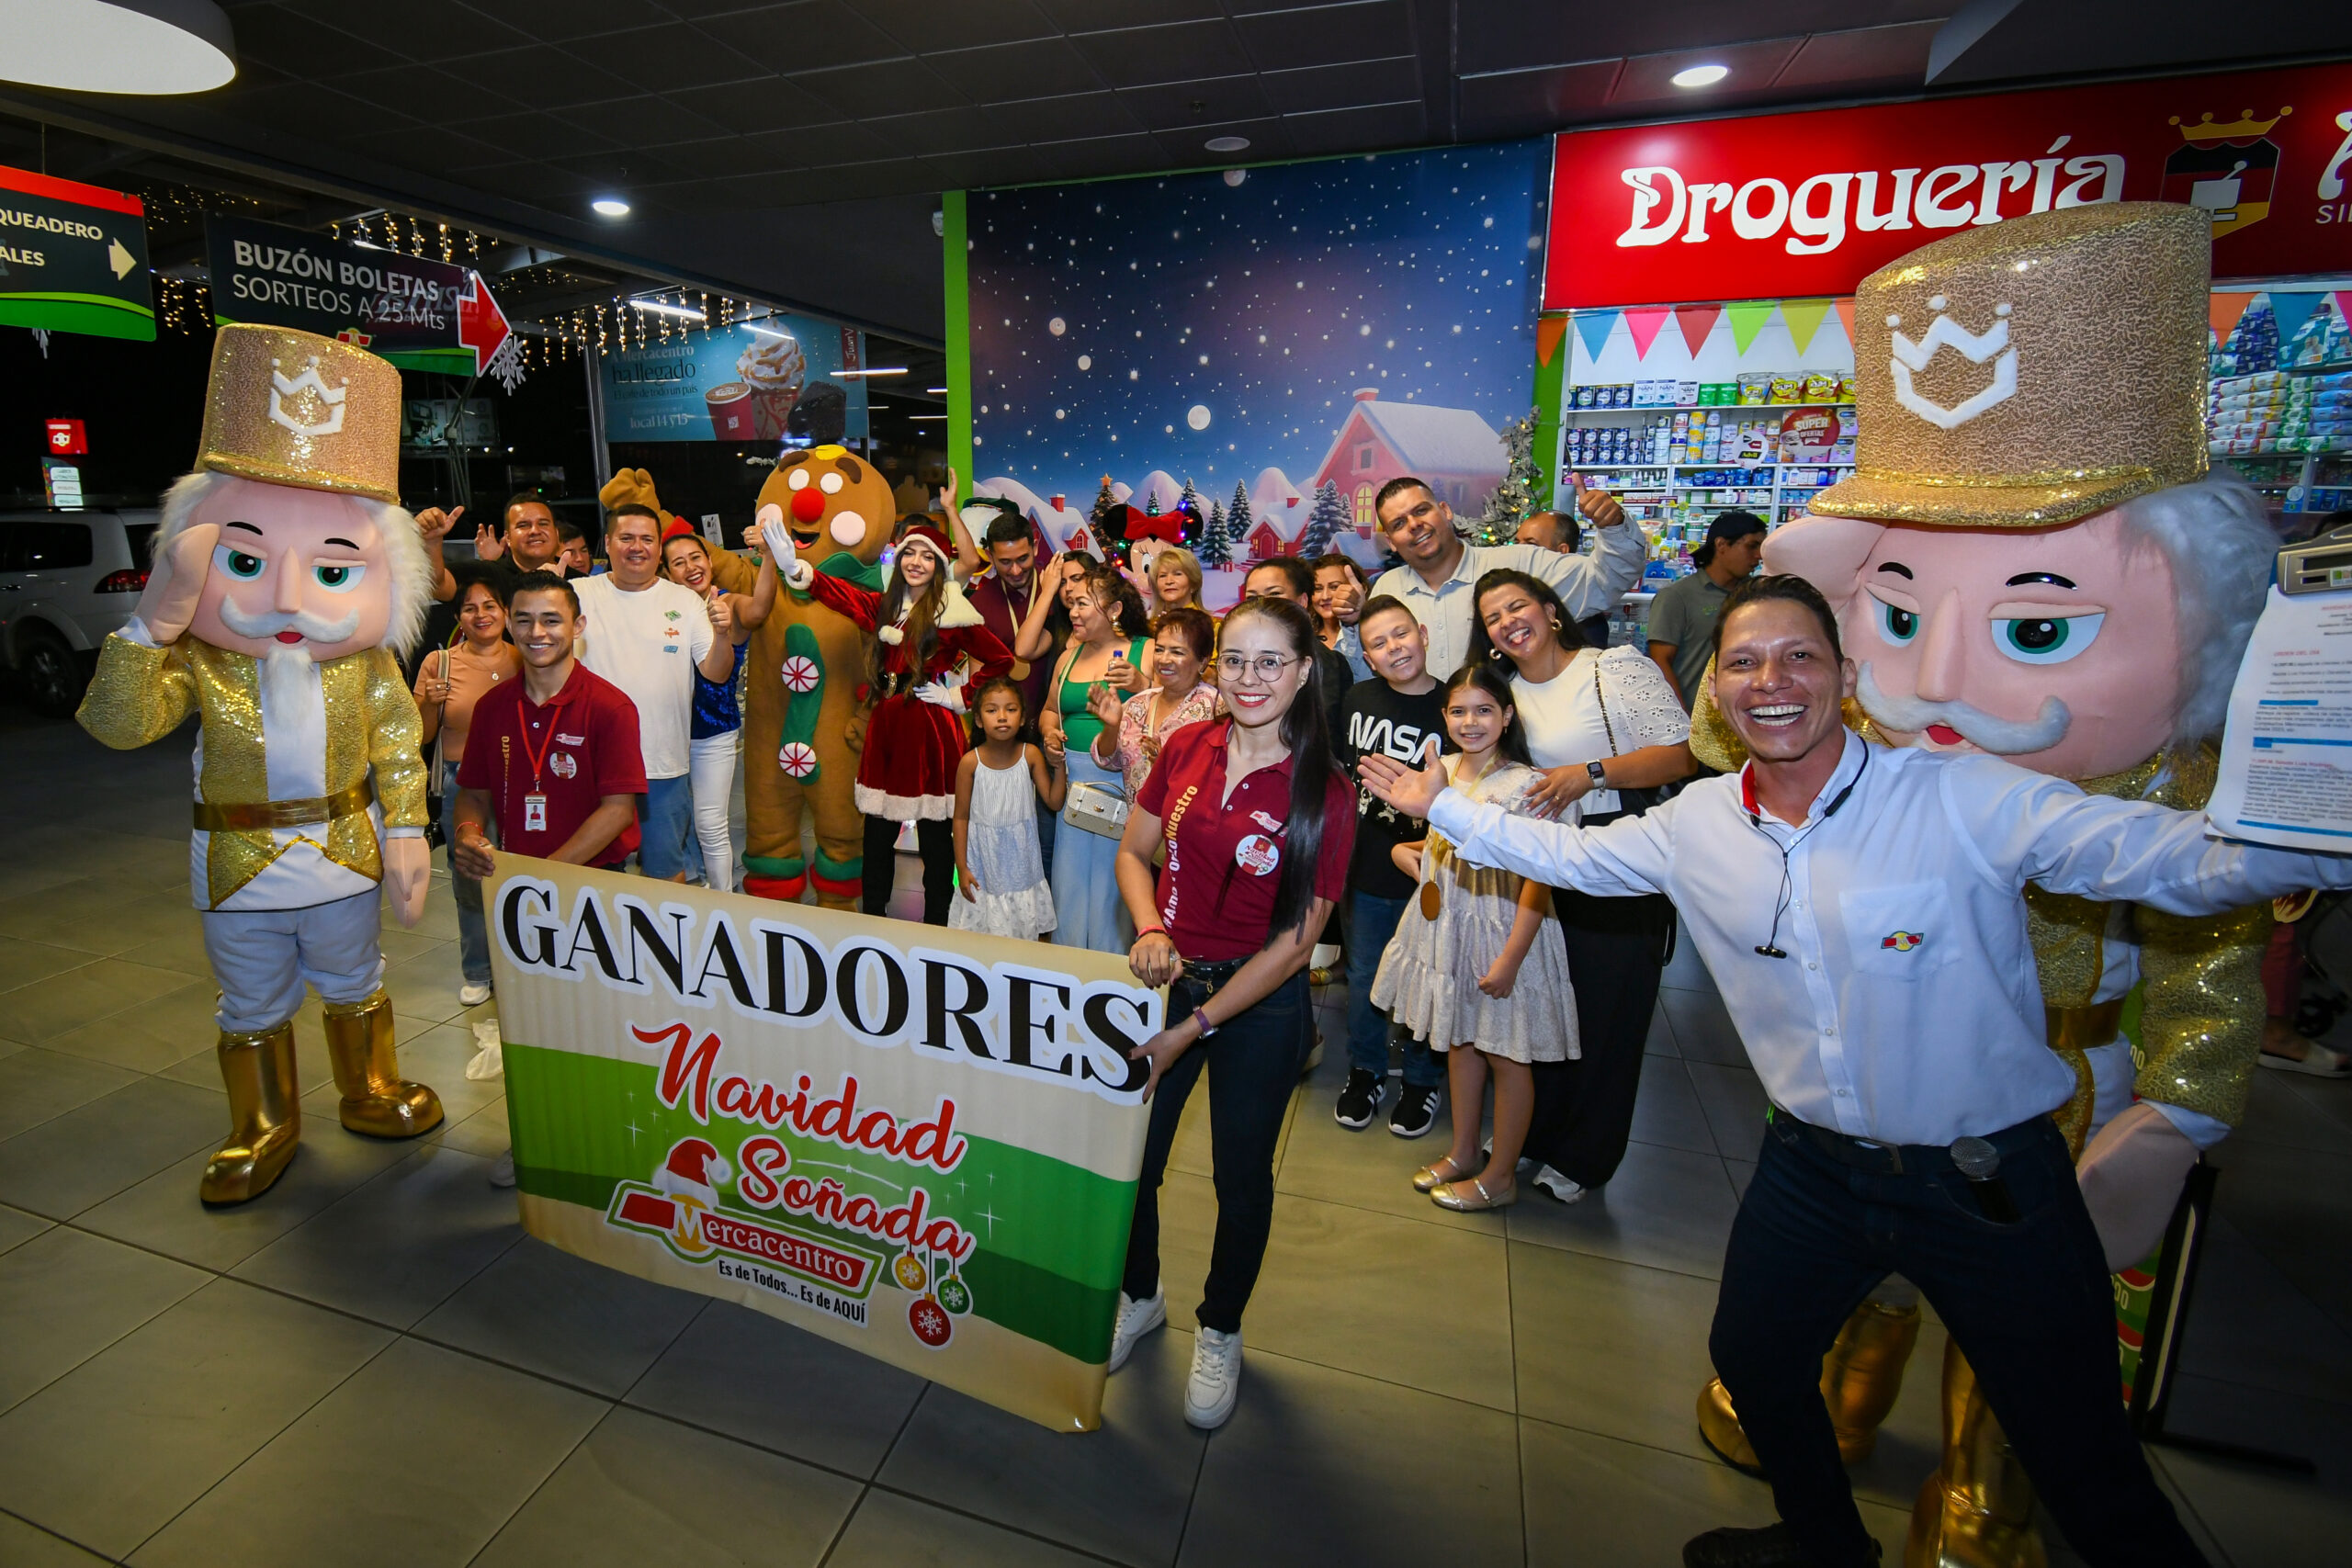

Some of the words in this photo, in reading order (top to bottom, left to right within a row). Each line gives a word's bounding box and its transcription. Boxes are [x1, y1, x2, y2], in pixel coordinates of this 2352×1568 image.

[1616, 136, 2126, 255] Droguería
[2315, 203, 2352, 224] SI
[233, 240, 334, 282] BUZÓN
[339, 261, 439, 301] BOLETAS
[232, 274, 352, 315] SORTEOS
[357, 297, 374, 319] A
[379, 299, 403, 323] 25
[410, 305, 446, 331] Mts
[612, 364, 632, 384] ha
[634, 358, 696, 386] llegado
[622, 345, 695, 362] Mercacentro
[630, 414, 655, 429] local
[655, 414, 669, 427] 14
[676, 412, 689, 426] 15
[1795, 417, 1829, 432] SUPER
[1348, 711, 1442, 764] NASA
[501, 885, 1151, 1093] GANADORES
[631, 1022, 968, 1169] Navidad
[741, 1137, 971, 1258] Soñada
[673, 1202, 854, 1281] Mercacentro
[718, 1259, 732, 1277] Es
[735, 1265, 750, 1281] de
[752, 1268, 798, 1299] Todos...
[800, 1284, 814, 1303] Es
[816, 1292, 831, 1310] de
[833, 1298, 865, 1324] AQUÍ
